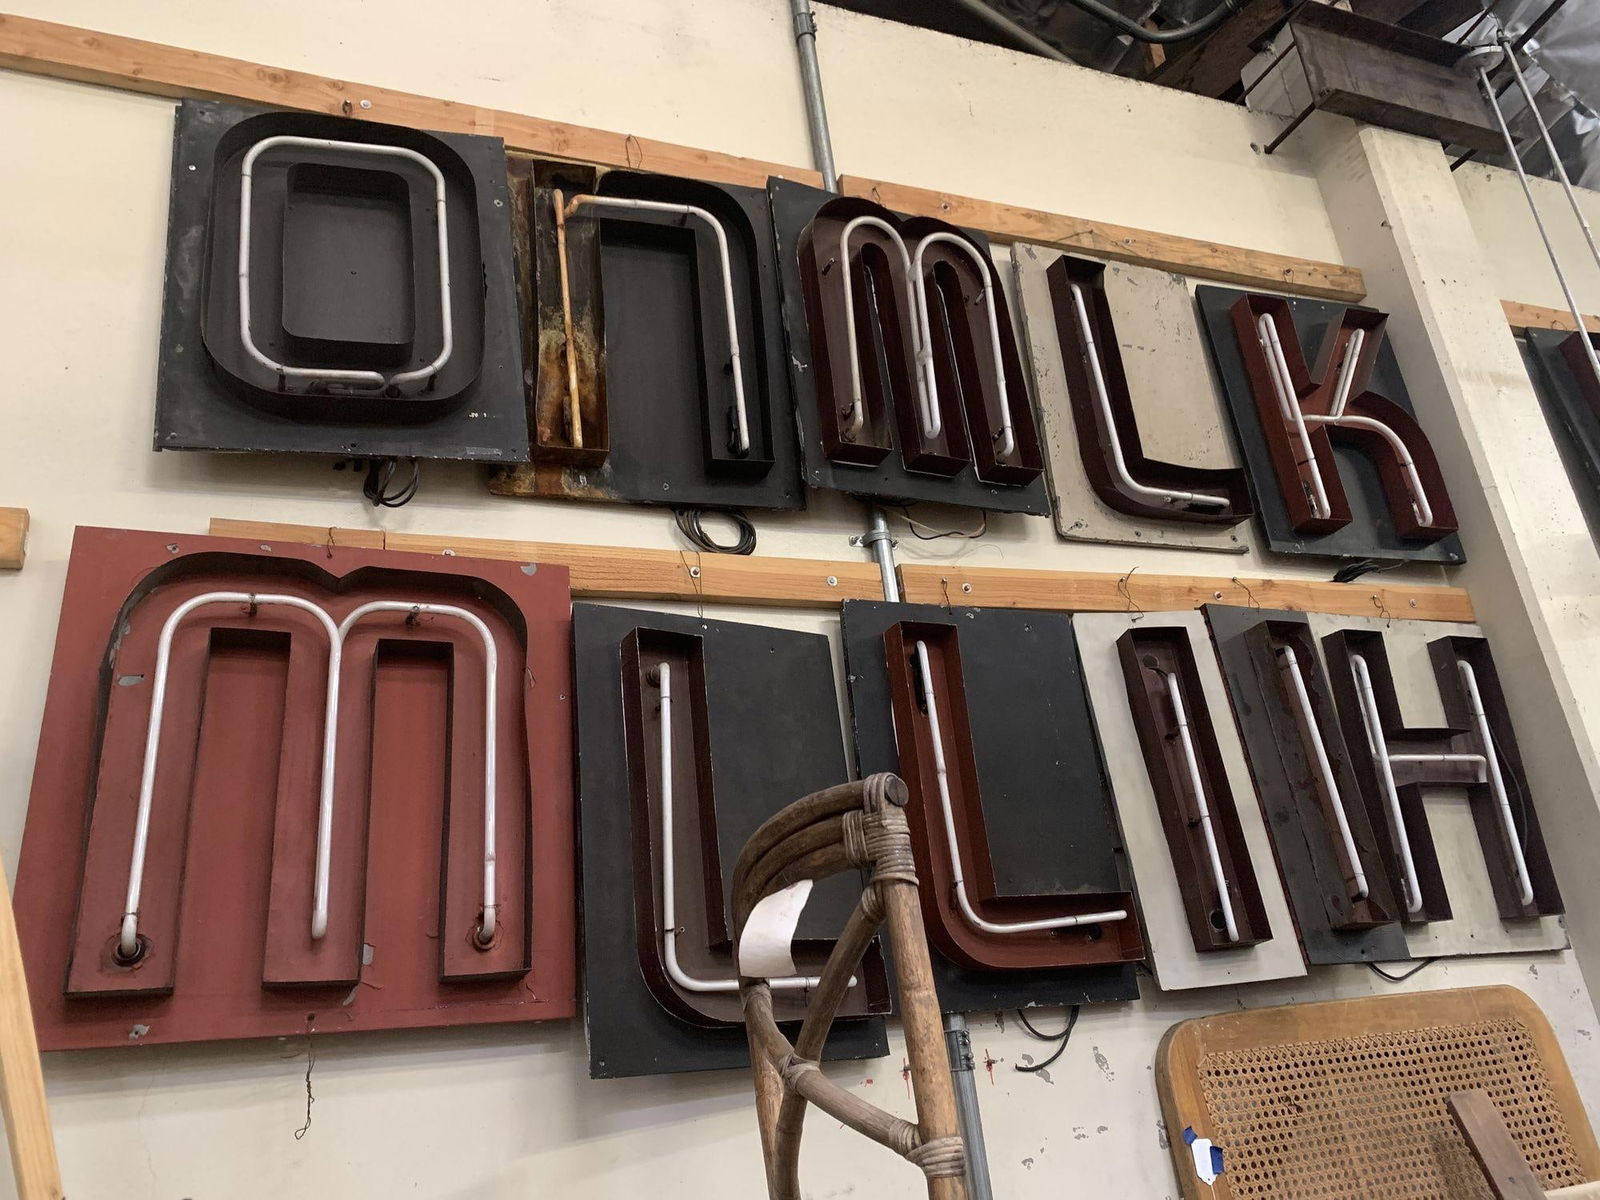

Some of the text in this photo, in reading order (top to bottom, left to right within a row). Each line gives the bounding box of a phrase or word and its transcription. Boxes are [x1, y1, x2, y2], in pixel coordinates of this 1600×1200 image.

[1047, 254, 1253, 526] L
[884, 621, 1145, 969] L
[1322, 629, 1565, 924] H
